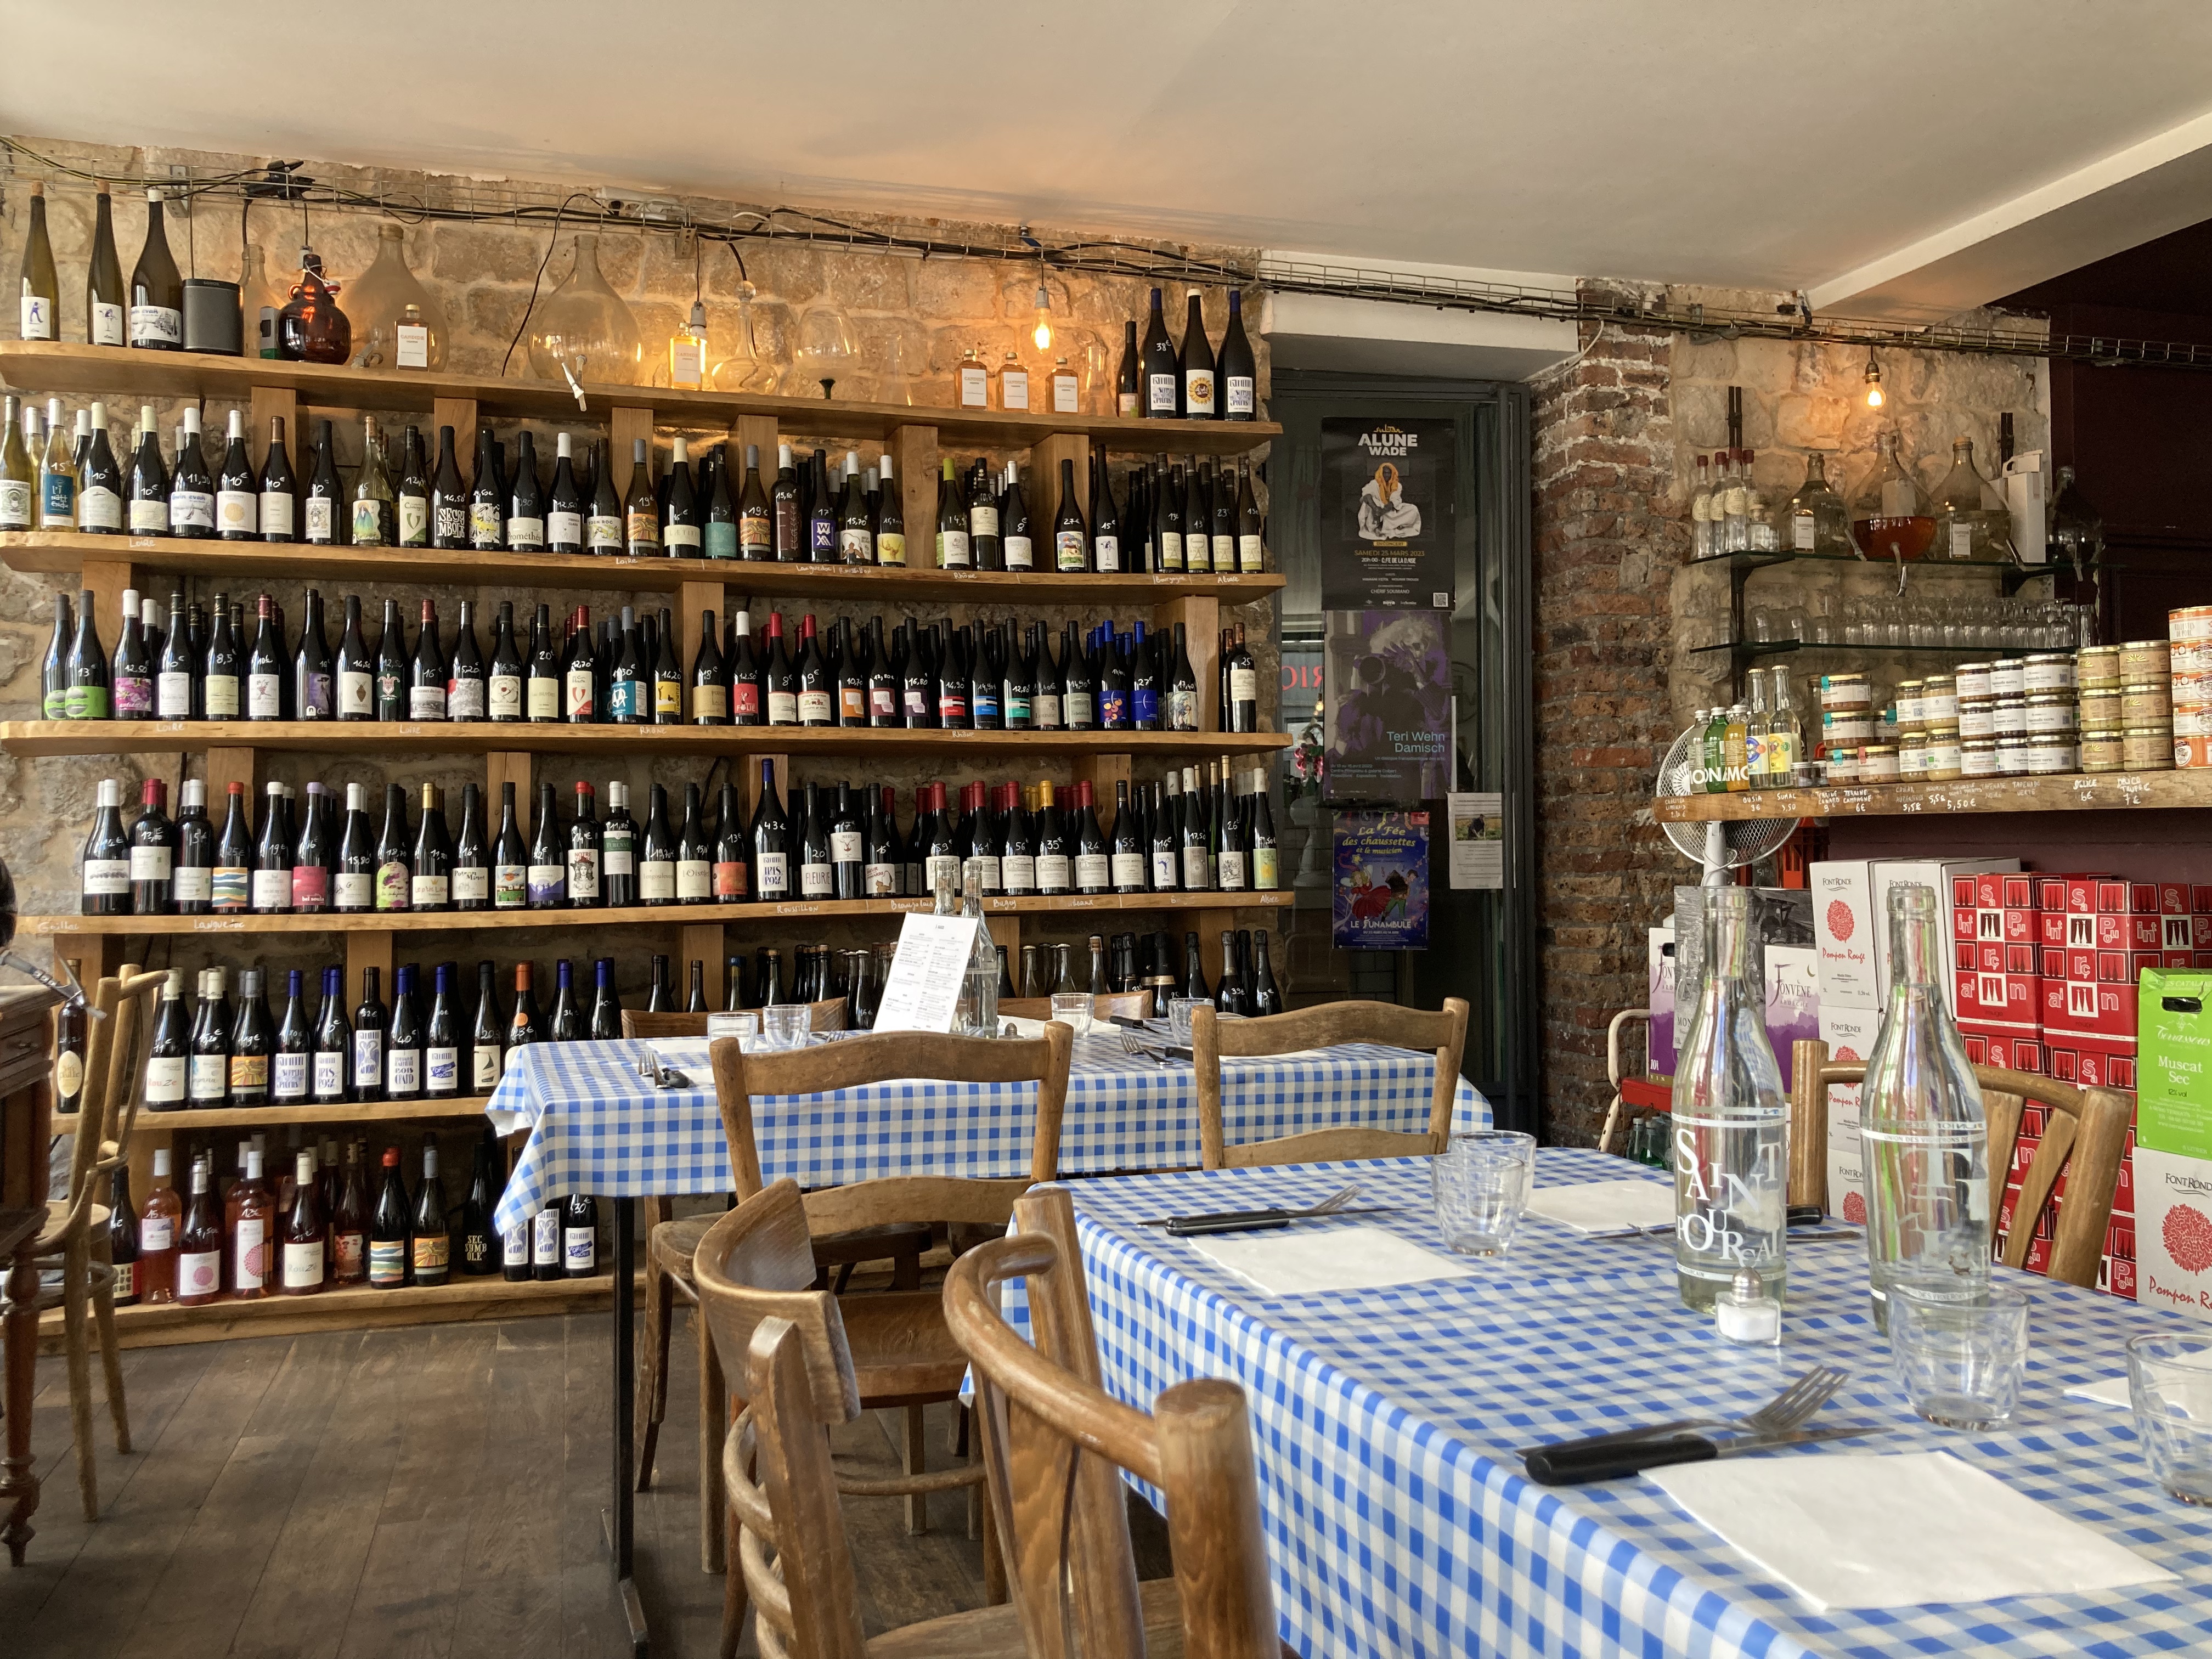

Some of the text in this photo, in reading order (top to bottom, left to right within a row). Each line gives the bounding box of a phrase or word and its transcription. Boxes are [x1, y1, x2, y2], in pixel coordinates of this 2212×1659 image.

[1156, 340, 1171, 352] 38€
[1358, 433, 1418, 447] ALUNE
[1369, 447, 1407, 456] WADE
[1386, 731, 1444, 741] Teri Wehn
[1395, 742, 1444, 753] Damisch
[1776, 793, 1796, 801] SUMAC
[2081, 790, 2093, 802] 6€
[1751, 804, 1761, 812] 3€
[1855, 803, 1866, 812] 6€
[1947, 799, 1968, 811] 5,50
[764, 821, 786, 830] 43€
[1357, 826, 1406, 836] La Fée
[1046, 836, 1063, 849] 35€
[1342, 836, 1416, 847] des chaussettes
[805, 871, 831, 885] FLEURIE
[1980, 884, 1996, 907] Sa
[2071, 888, 2088, 912] Sa
[890, 900, 934, 913] Beaujolais
[993, 899, 1017, 909] Bugey
[1363, 916, 1412, 929] FUNAMBULE
[1957, 913, 1973, 934] int
[2045, 918, 2063, 940] int
[1822, 947, 1866, 964] Pompon Rouge
[2158, 1055, 2203, 1074] Muscat
[2168, 1071, 2190, 1085] Sec
[1829, 1091, 1854, 1110] Pompon
[1676, 1127, 1782, 1214] SAINT
[467, 1235, 482, 1244] SEC
[2149, 1275, 2196, 1305] Pompon
